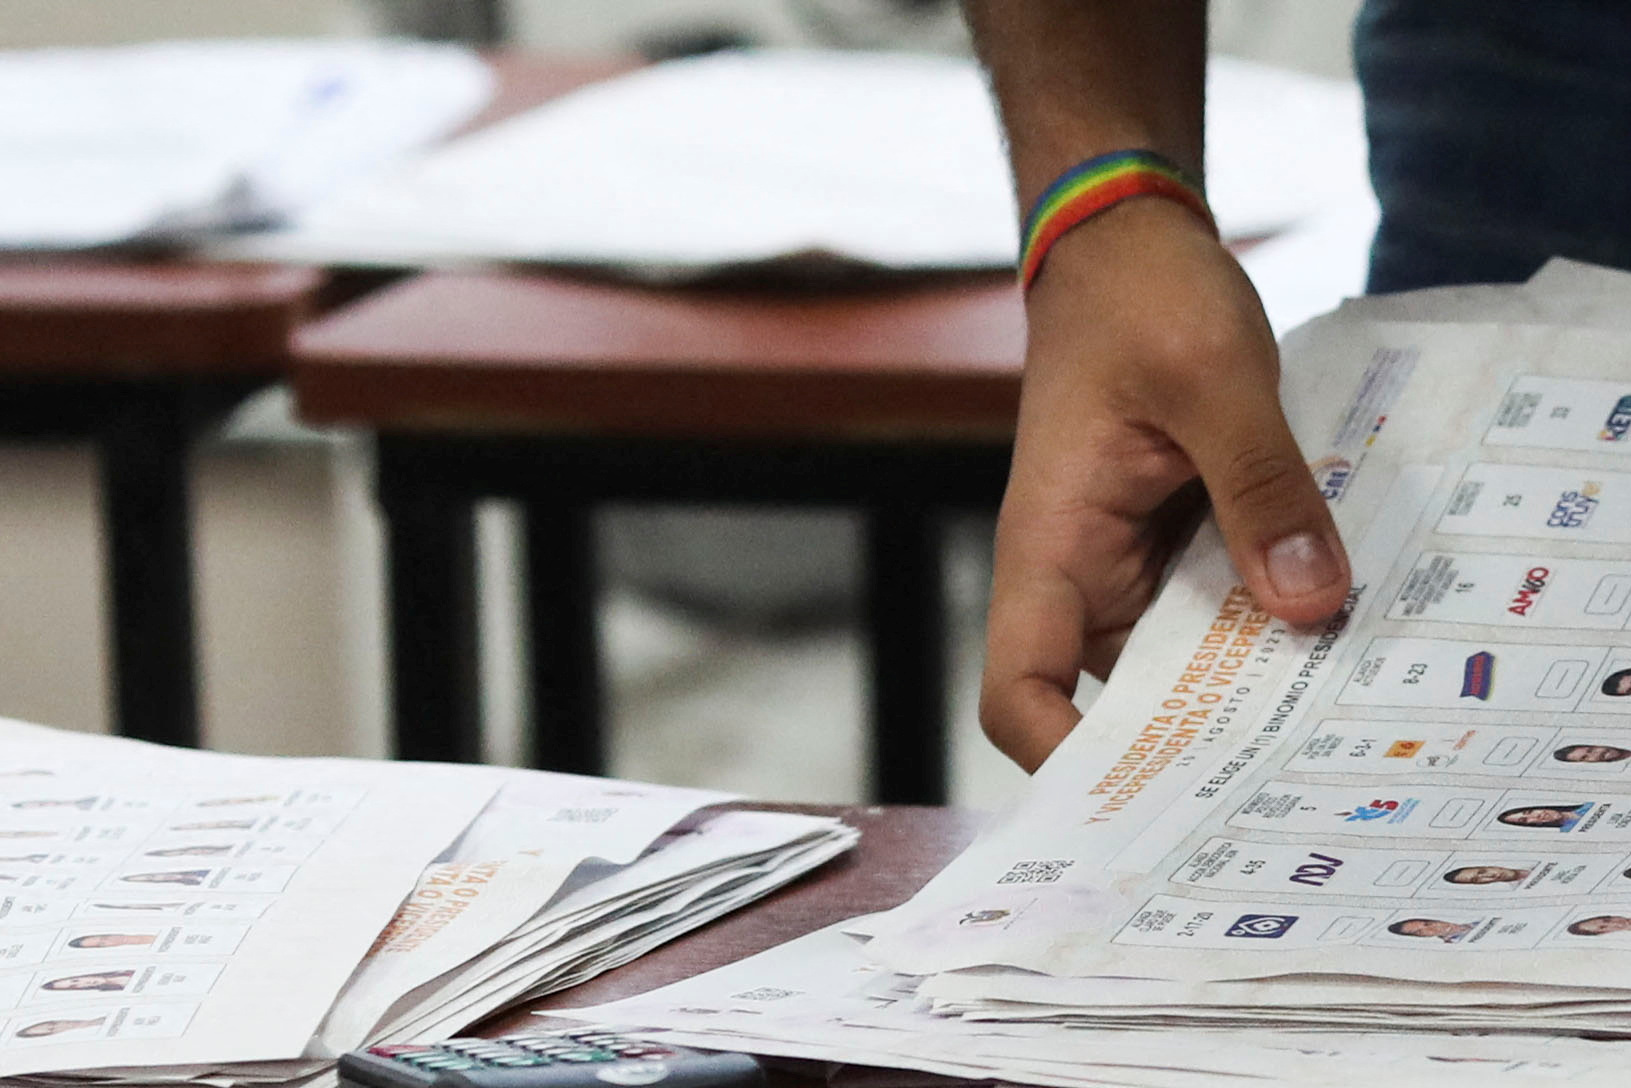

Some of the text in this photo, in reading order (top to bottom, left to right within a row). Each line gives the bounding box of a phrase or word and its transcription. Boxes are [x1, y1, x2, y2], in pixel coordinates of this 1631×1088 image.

[1454, 582, 1474, 593] 16
[1088, 583, 1253, 795] PRESIDENTA O PRESIDENTE
[1202, 687, 1250, 743] AGOSTO
[1255, 629, 1285, 664] 2023
[1401, 662, 1429, 684] 8-23
[1085, 813, 1109, 825] Y
[1101, 708, 1212, 813] VICEPRESIDENTA
[1197, 692, 1222, 705] O
[1195, 785, 1218, 798] SE
[1210, 760, 1246, 790] ELIGE
[1242, 743, 1261, 761] UN
[1252, 732, 1271, 749] (1)
[1263, 680, 1307, 735] BINOMIO
[1237, 859, 1267, 875] 4-35
[1175, 911, 1214, 936] 2-17-20
